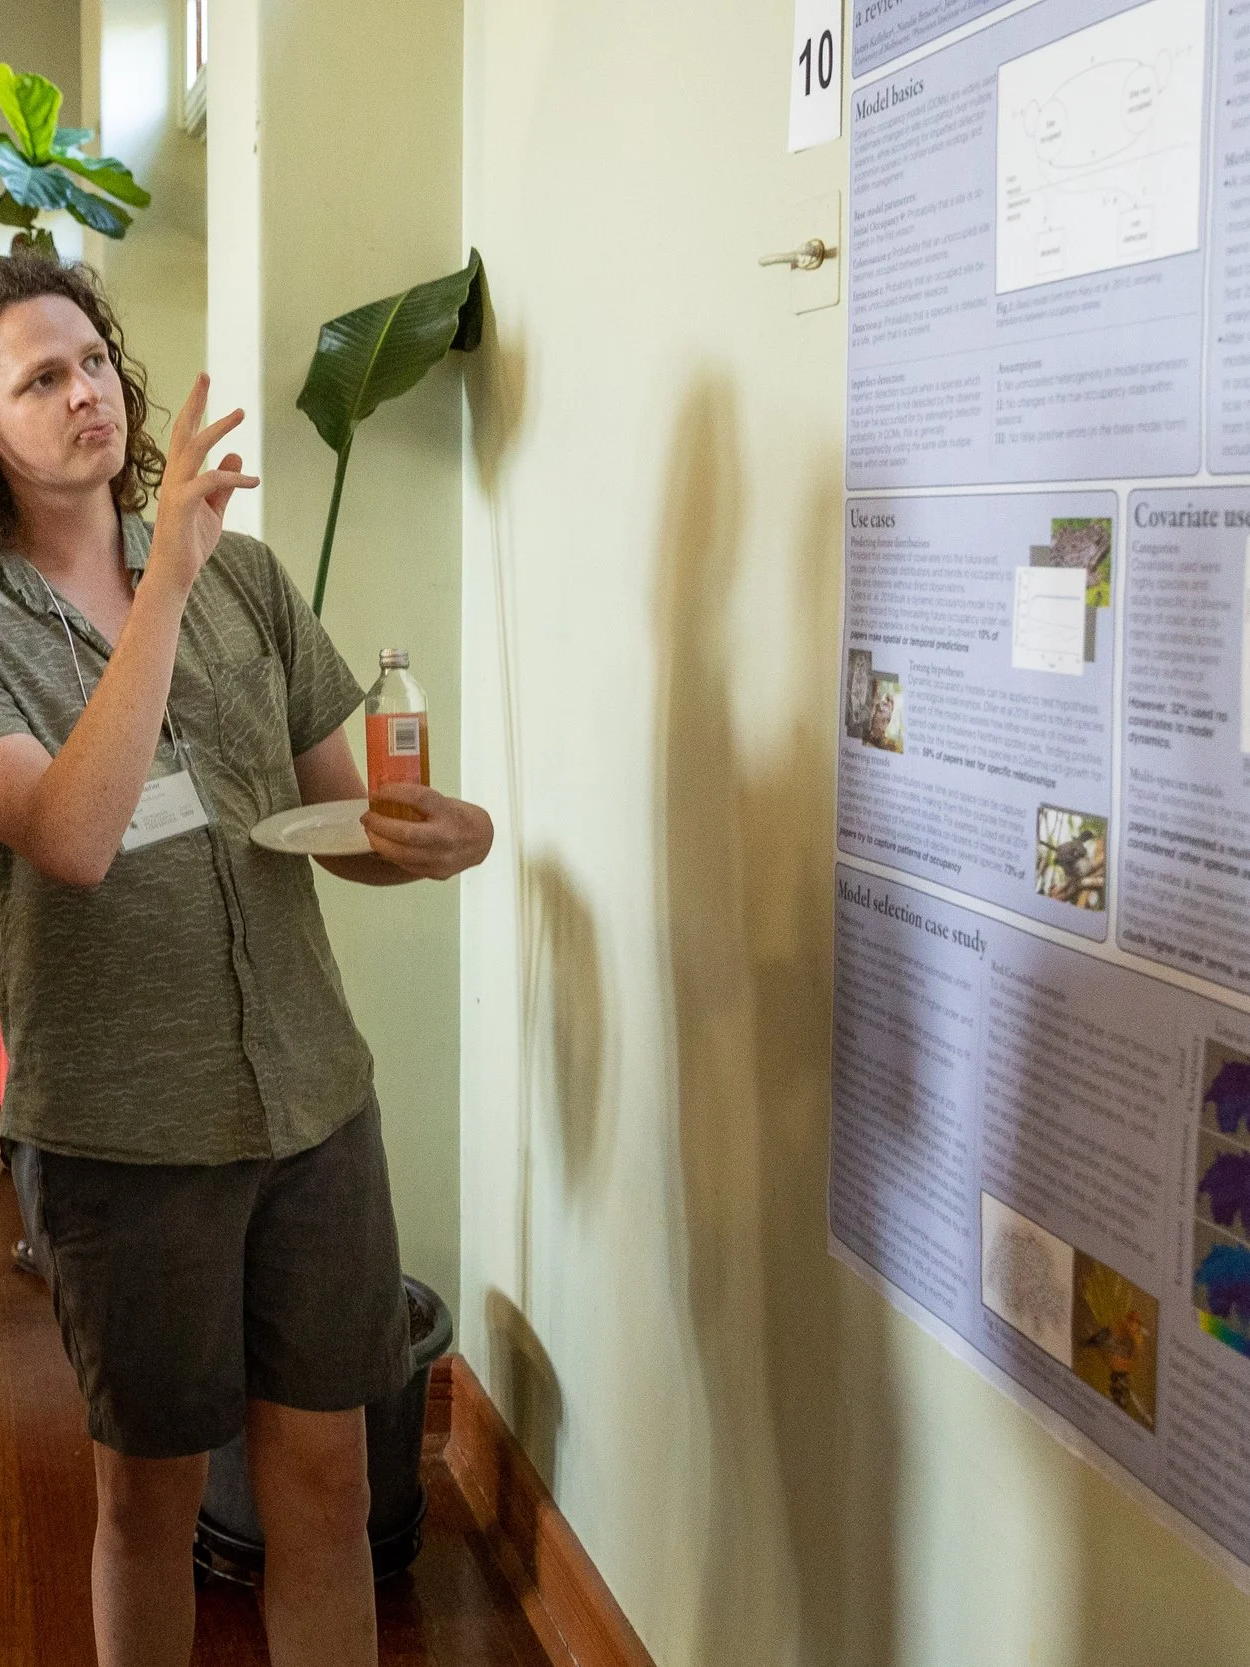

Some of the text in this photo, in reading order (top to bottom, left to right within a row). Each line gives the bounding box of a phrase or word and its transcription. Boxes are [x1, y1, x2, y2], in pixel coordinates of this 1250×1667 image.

[855, 0, 905, 28] a revie
[799, 29, 833, 96] 10
[855, 79, 924, 122] Model basics
[851, 509, 895, 528] Use cases
[1134, 502, 1219, 529] Covariate
[929, 853, 961, 872] occupancy
[838, 879, 871, 910] Model
[873, 894, 922, 930] selection
[924, 917, 950, 940] case
[951, 927, 988, 960] study
